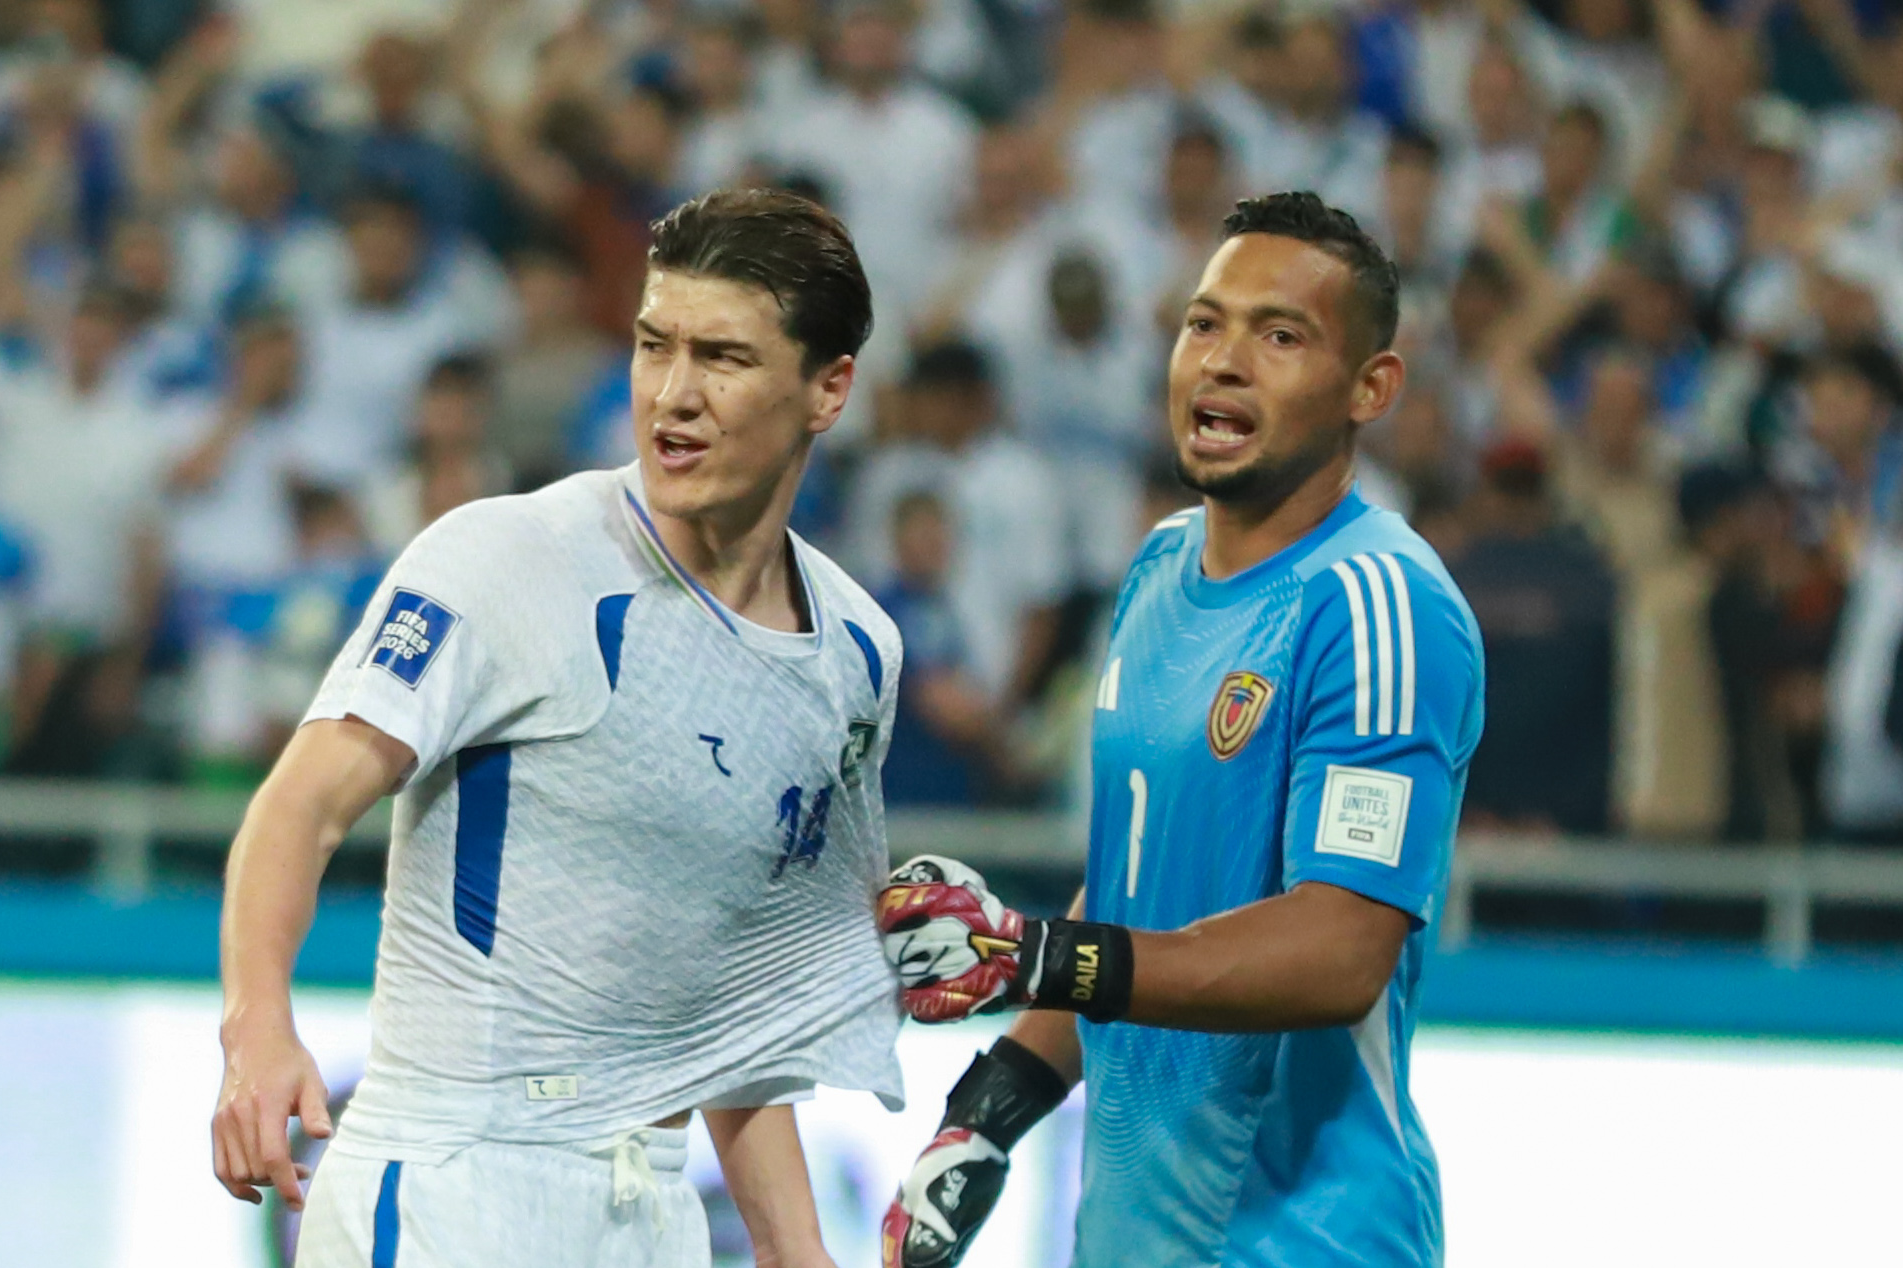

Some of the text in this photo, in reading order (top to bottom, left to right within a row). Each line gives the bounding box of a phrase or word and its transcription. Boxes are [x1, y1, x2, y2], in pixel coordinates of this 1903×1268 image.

[396, 610, 428, 635] FIFA
[378, 636, 415, 660] 2026
[382, 623, 431, 653] SERIES
[1343, 796, 1389, 816] UNITES
[1127, 769, 1147, 898] 1
[1072, 944, 1101, 1001] DAILA
